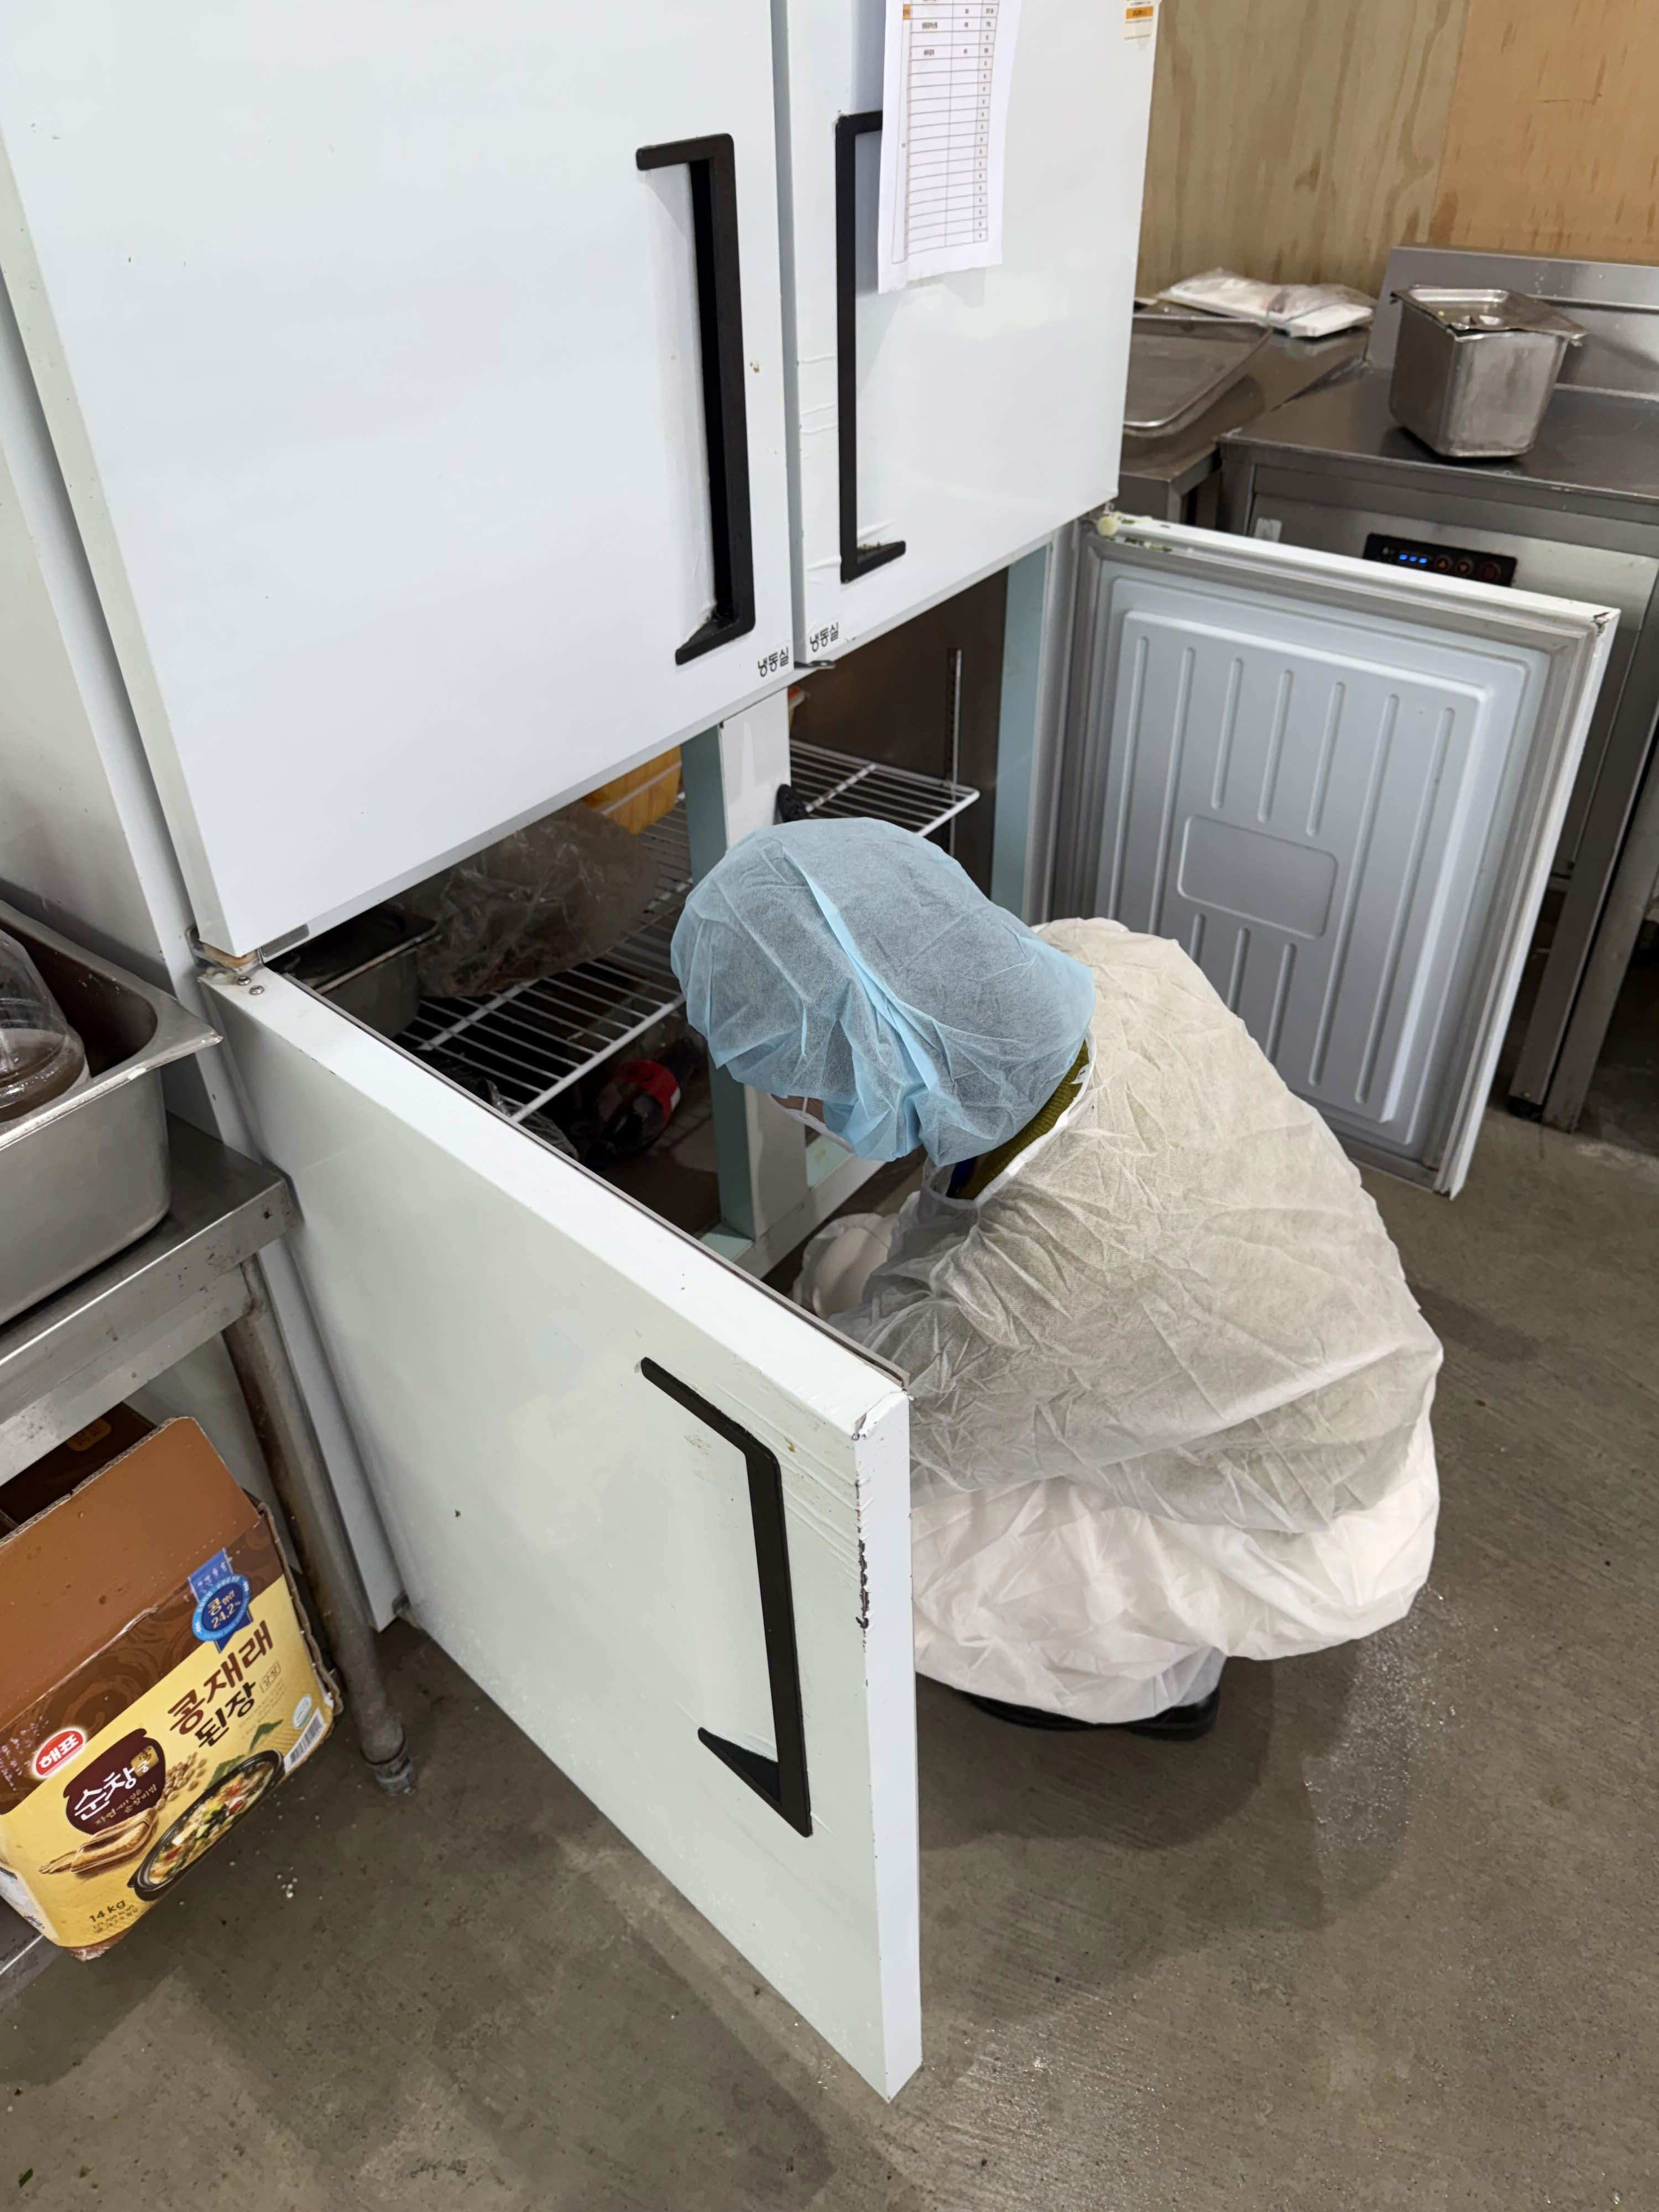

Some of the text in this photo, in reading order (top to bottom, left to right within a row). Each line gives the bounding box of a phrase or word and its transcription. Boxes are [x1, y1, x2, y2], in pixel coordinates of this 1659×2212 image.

[810, 622, 839, 653] 냉동실
[758, 646, 789, 677] 냉동실
[207, 1598, 222, 1616] 콩
[168, 1620, 274, 1735] 콩재래
[195, 1682, 256, 1747] 된장
[39, 1734, 79, 1768] 해표
[89, 1911, 106, 1923] 14
[107, 1900, 126, 1913] kg
